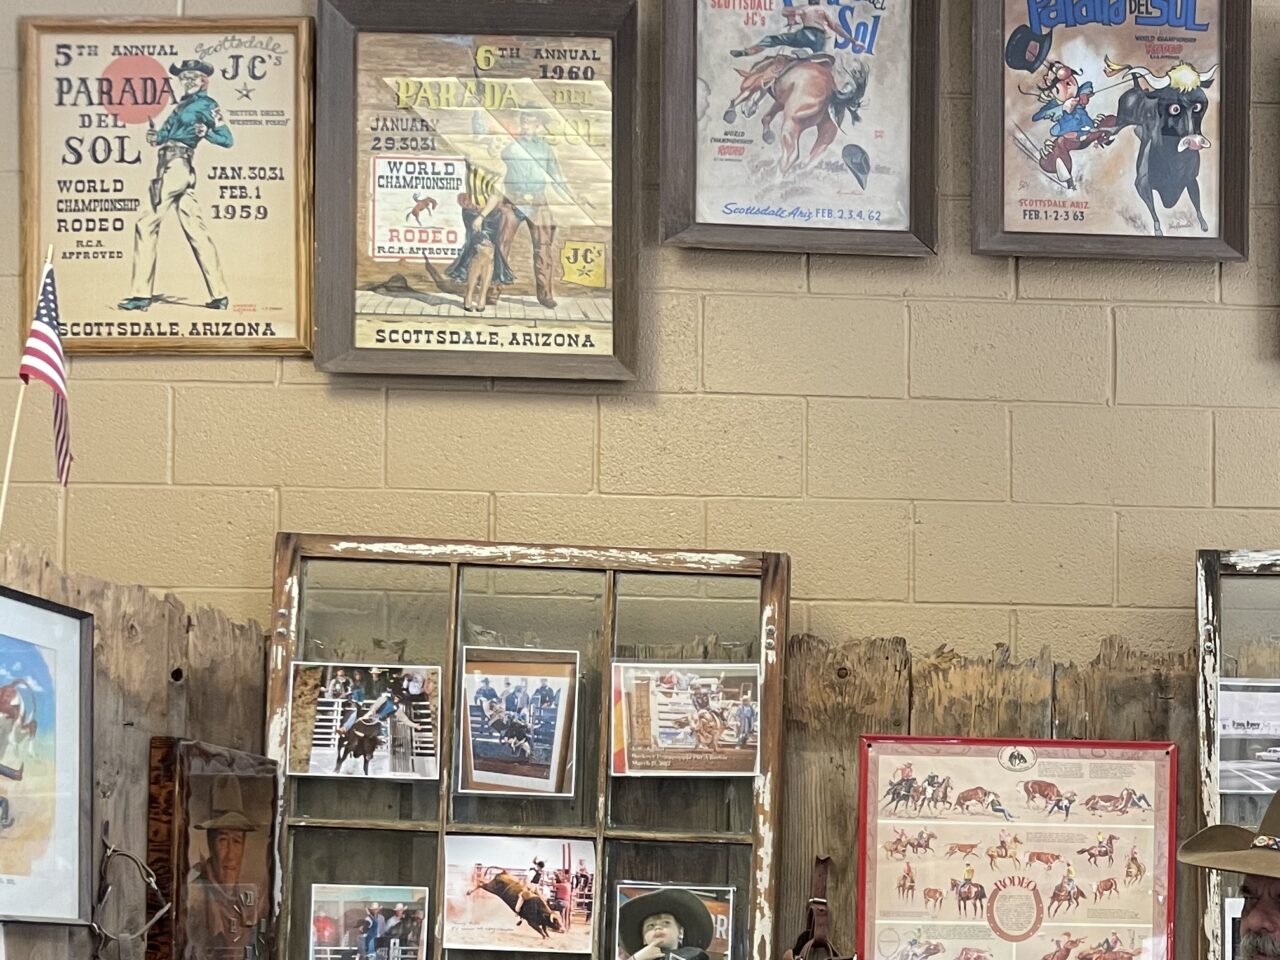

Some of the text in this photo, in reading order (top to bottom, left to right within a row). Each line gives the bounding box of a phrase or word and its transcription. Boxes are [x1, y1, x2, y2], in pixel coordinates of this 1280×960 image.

[834, 5, 882, 56] Sol
[54, 44, 178, 68] 5TH ANNUAL
[195, 36, 288, 60] Scottsdale
[475, 44, 601, 72] 6TH ANNUAL
[538, 64, 596, 80] 1960
[54, 76, 178, 106] PARADA
[395, 78, 521, 110] PARADA
[80, 114, 127, 129] DEL
[370, 117, 441, 132] JANUARY
[62, 135, 142, 165] SOL
[388, 160, 456, 176] WORLD
[57, 179, 124, 193] WORLD
[378, 175, 463, 191] CHAMPIONSHIP
[219, 186, 252, 200] FEB.
[57, 198, 140, 212] CHAMPIONSHIP
[211, 204, 269, 220] 1959
[57, 218, 124, 232] RODEO
[388, 228, 458, 244] RODEO
[61, 250, 124, 260] APPROVED
[189, 322, 276, 336] ARIZONA
[376, 329, 595, 348] SCOTTSDALE, ARIZONA
[992, 876, 1037, 892] RODEO
